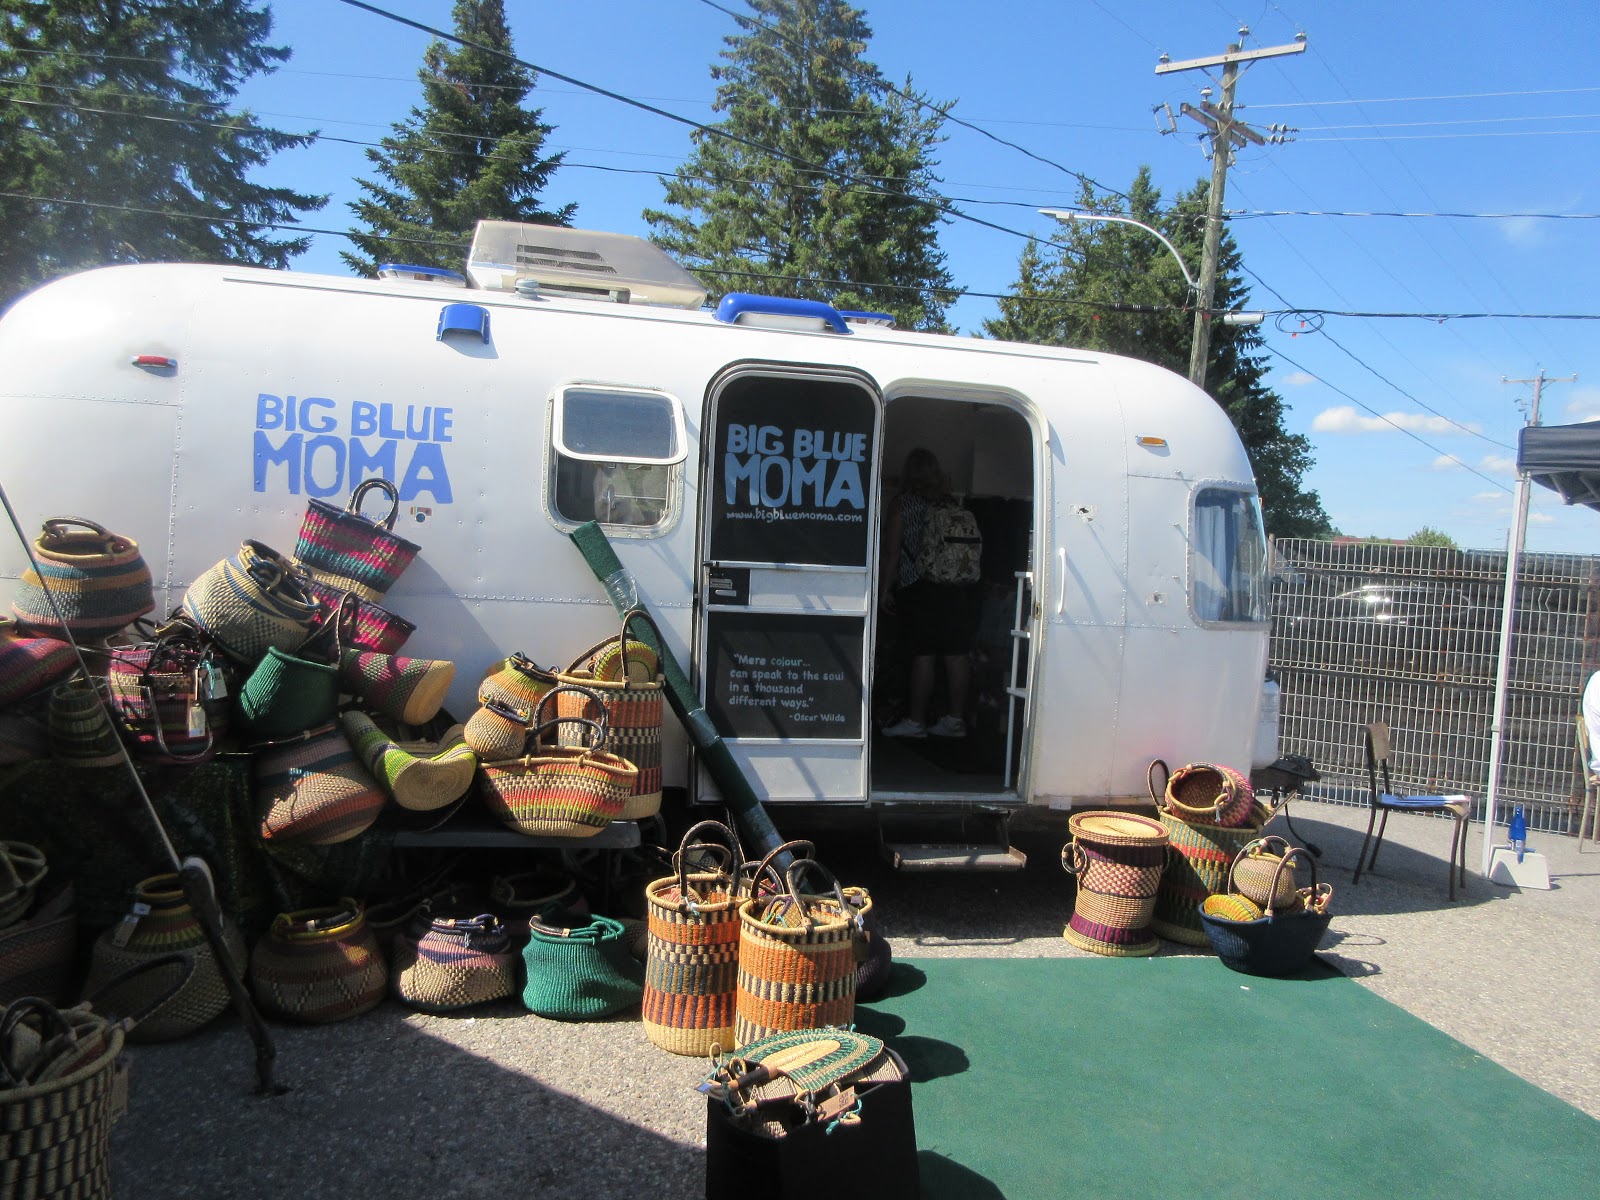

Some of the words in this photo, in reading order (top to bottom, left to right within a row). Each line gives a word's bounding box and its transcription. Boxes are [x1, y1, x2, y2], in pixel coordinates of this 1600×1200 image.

[256, 393, 338, 433] BIG
[351, 400, 453, 442] BLUE
[727, 423, 784, 455] BIG
[793, 428, 867, 462] BLUE
[253, 430, 454, 504] MOMA
[724, 452, 866, 510] MOMA
[726, 508, 863, 523] www.bigbluemoma.com
[730, 669, 748, 678] can
[752, 669, 782, 681] speak
[787, 670, 798, 680] to
[803, 670, 819, 681] the
[823, 671, 844, 681] soul
[729, 681, 739, 692] in
[743, 683, 749, 692] a
[754, 682, 804, 694] thousand
[729, 695, 777, 707] different
[820, 713, 846, 722] Wilde
